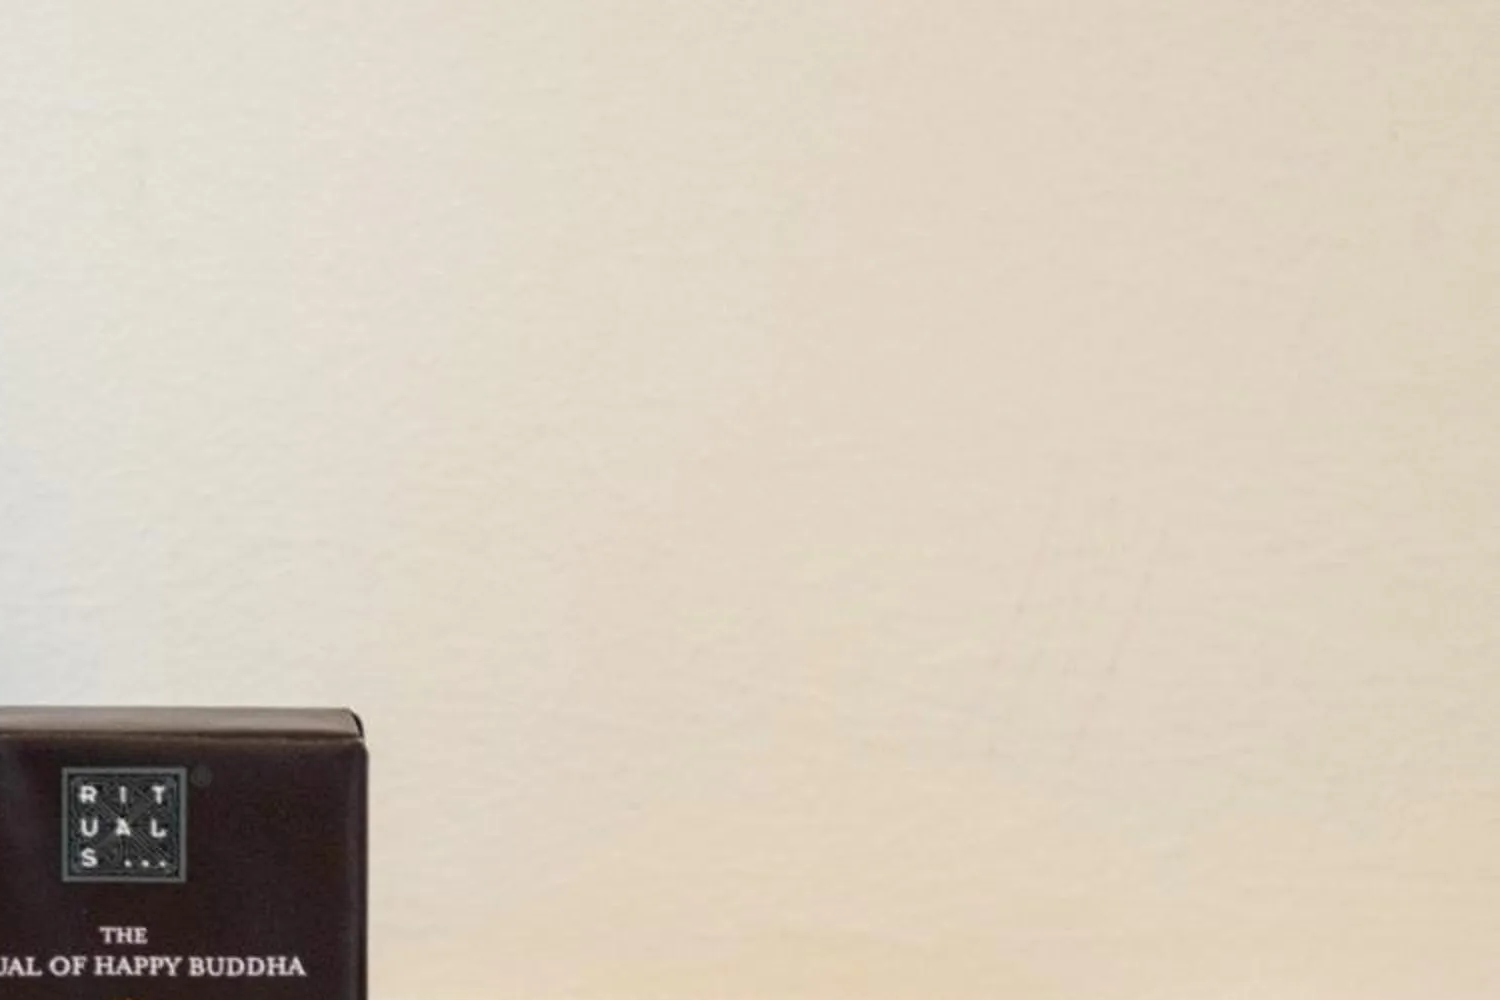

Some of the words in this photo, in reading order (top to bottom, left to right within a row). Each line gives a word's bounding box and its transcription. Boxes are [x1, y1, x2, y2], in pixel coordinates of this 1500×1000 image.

[99, 926, 149, 945] THE
[49, 956, 88, 977] OF
[94, 956, 182, 978] HAPPY
[188, 955, 308, 977] BUDDHA
